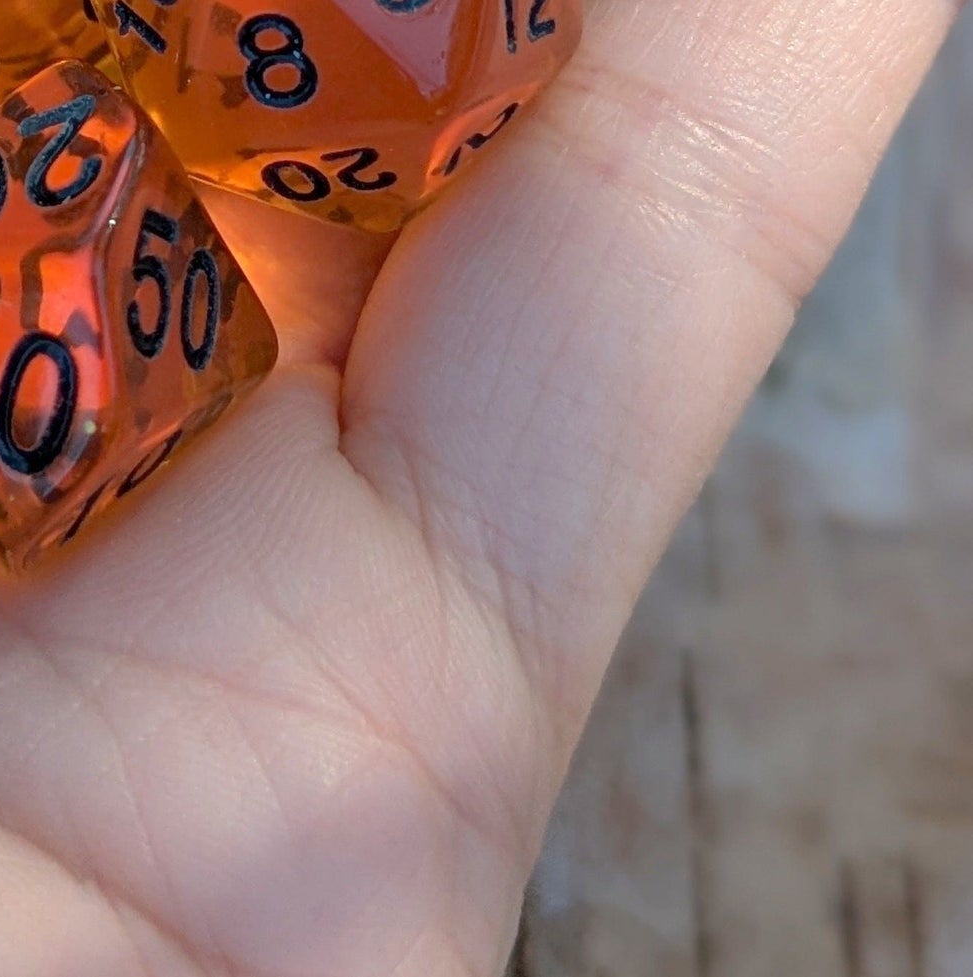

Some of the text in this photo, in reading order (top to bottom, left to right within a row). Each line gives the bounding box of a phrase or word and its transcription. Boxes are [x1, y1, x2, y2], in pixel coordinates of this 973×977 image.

[236, 13, 319, 109] 8
[261, 147, 398, 204] 20
[128, 208, 221, 372] 50
